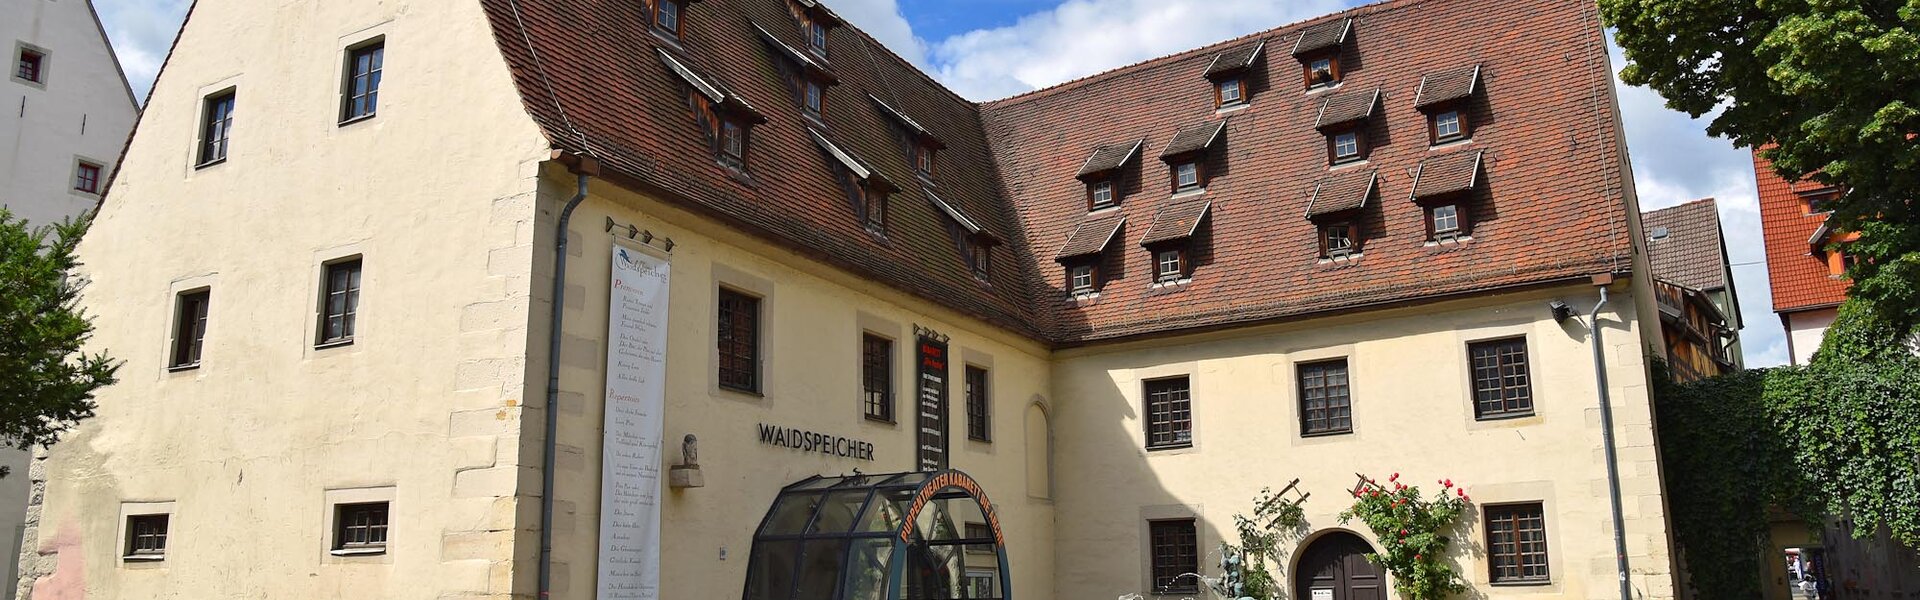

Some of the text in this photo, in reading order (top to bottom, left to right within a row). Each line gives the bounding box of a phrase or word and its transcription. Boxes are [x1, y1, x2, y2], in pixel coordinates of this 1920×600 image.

[759, 422, 875, 461] WAIDSPEICHER
[901, 472, 949, 543] PUPPENTHEATER
[949, 471, 981, 499] KABARETT
[979, 494, 990, 513] DIE
